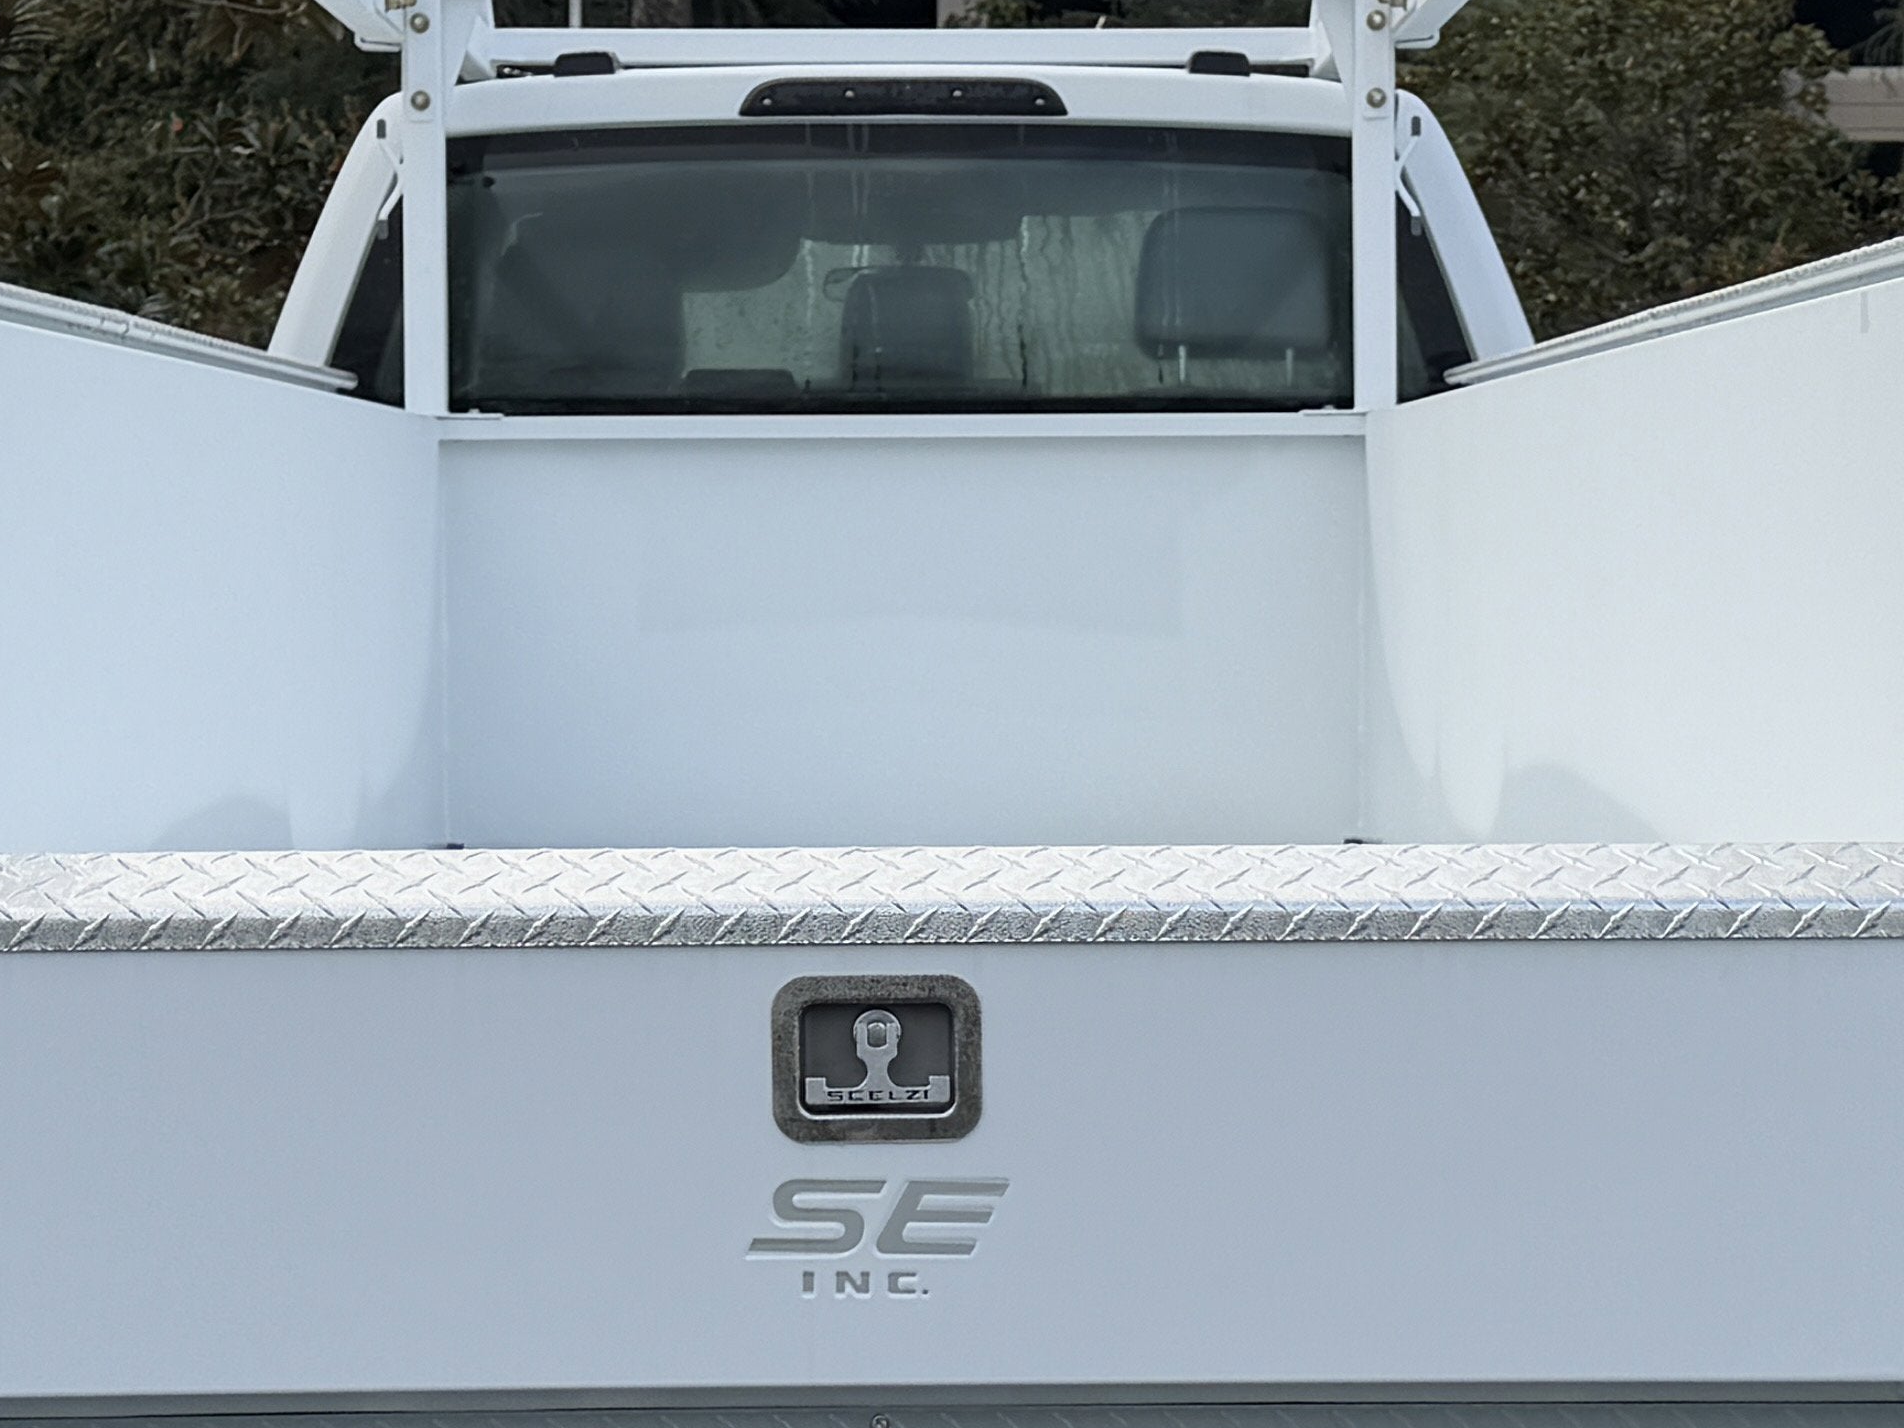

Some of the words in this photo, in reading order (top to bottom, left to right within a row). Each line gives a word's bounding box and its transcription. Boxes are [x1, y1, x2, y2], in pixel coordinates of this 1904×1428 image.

[826, 1090, 930, 1102] SCELZI
[747, 1178, 1010, 1255] SE
[801, 1270, 929, 1295] INC.
